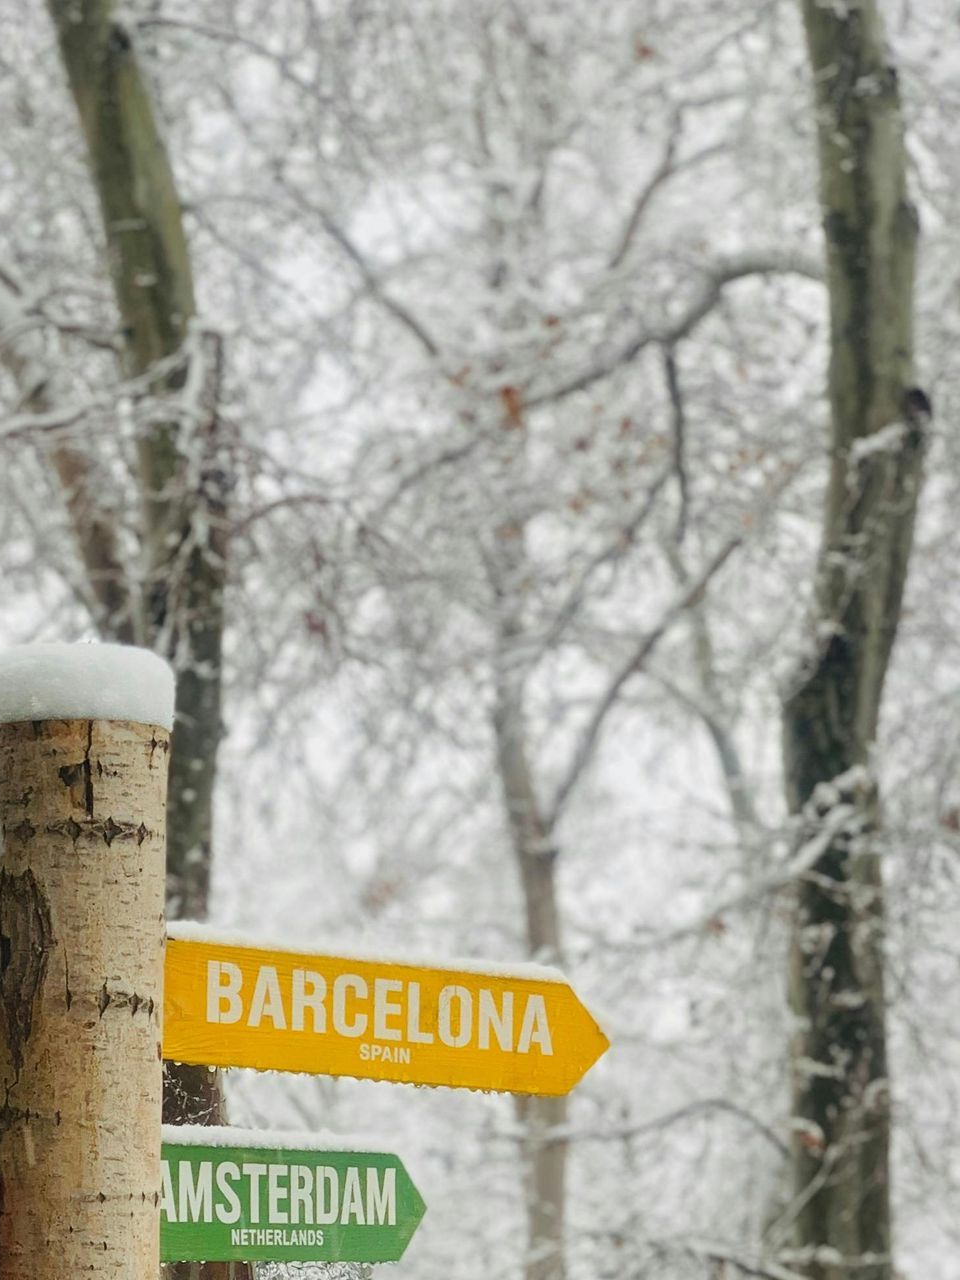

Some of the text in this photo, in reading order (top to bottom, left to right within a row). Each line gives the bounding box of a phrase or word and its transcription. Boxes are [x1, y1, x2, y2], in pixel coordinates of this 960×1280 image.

[205, 960, 553, 1056] BARCELONA
[359, 1043, 411, 1064] SPAIN
[231, 1229, 324, 1246] NETHERLANDS
